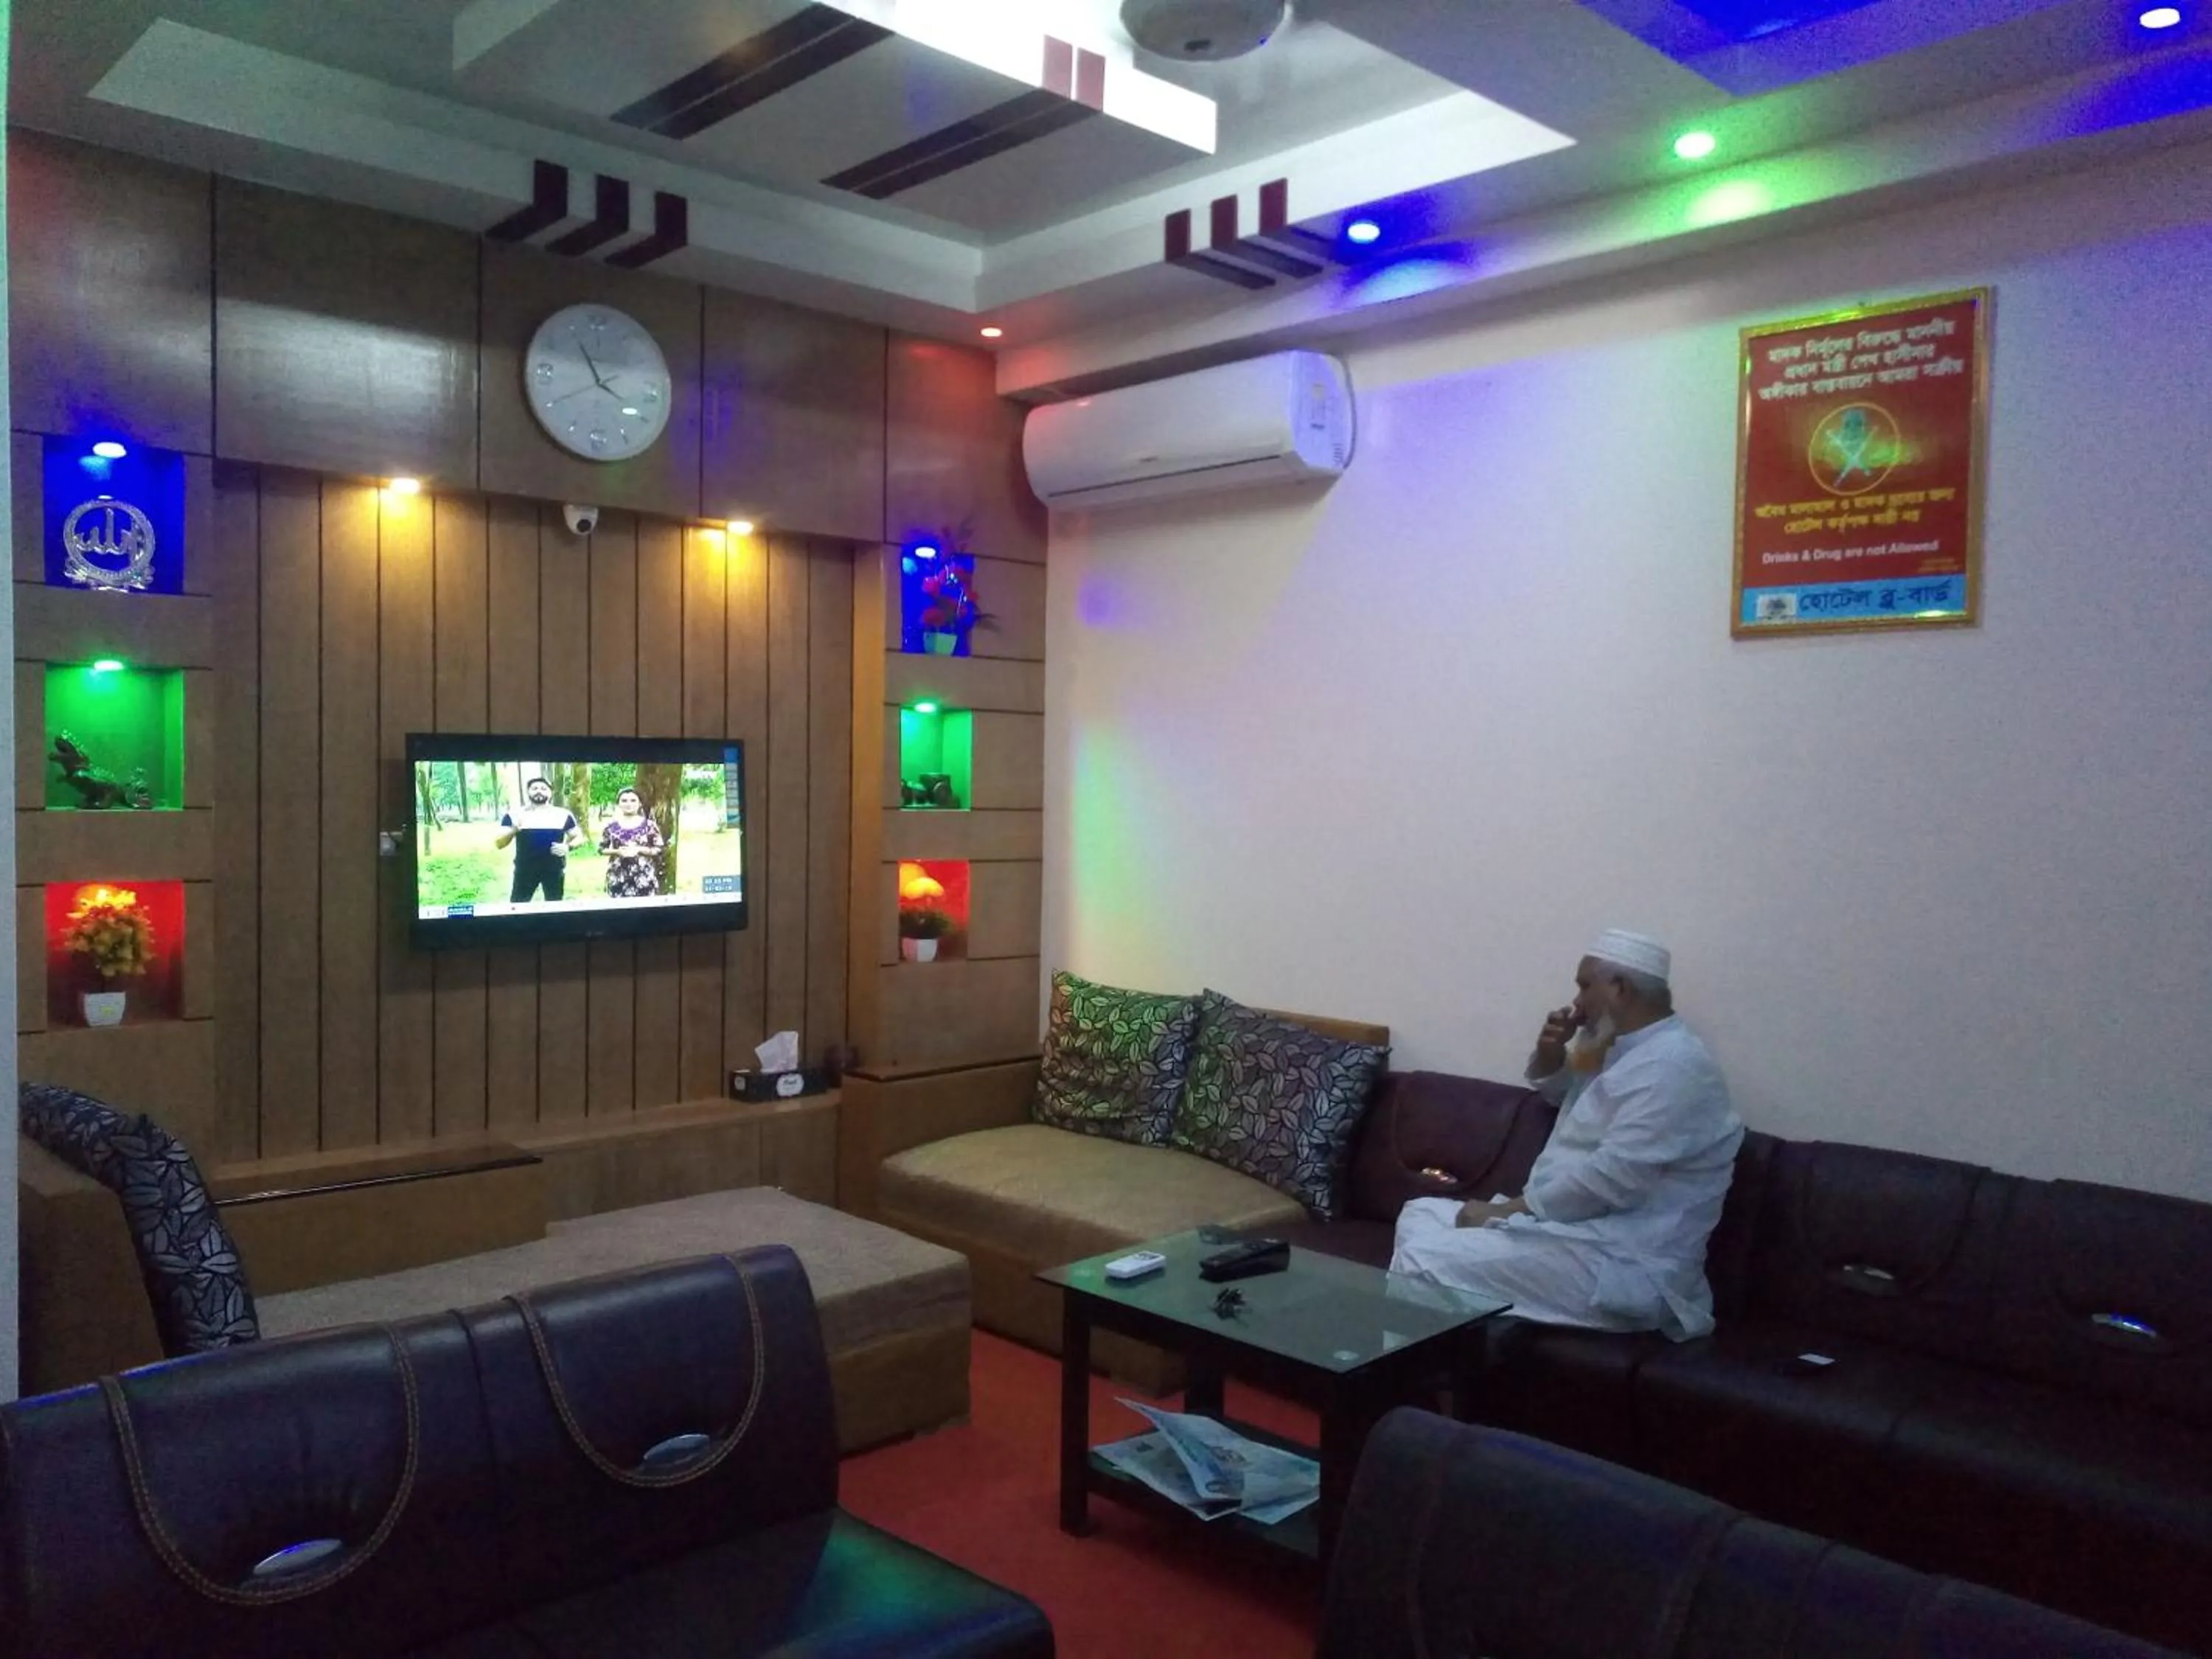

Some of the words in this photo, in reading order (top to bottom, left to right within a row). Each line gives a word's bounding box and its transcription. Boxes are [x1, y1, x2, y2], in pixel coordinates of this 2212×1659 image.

[1813, 548, 1842, 562] Drug
[1845, 547, 1863, 558] are
[1866, 543, 1886, 556] not
